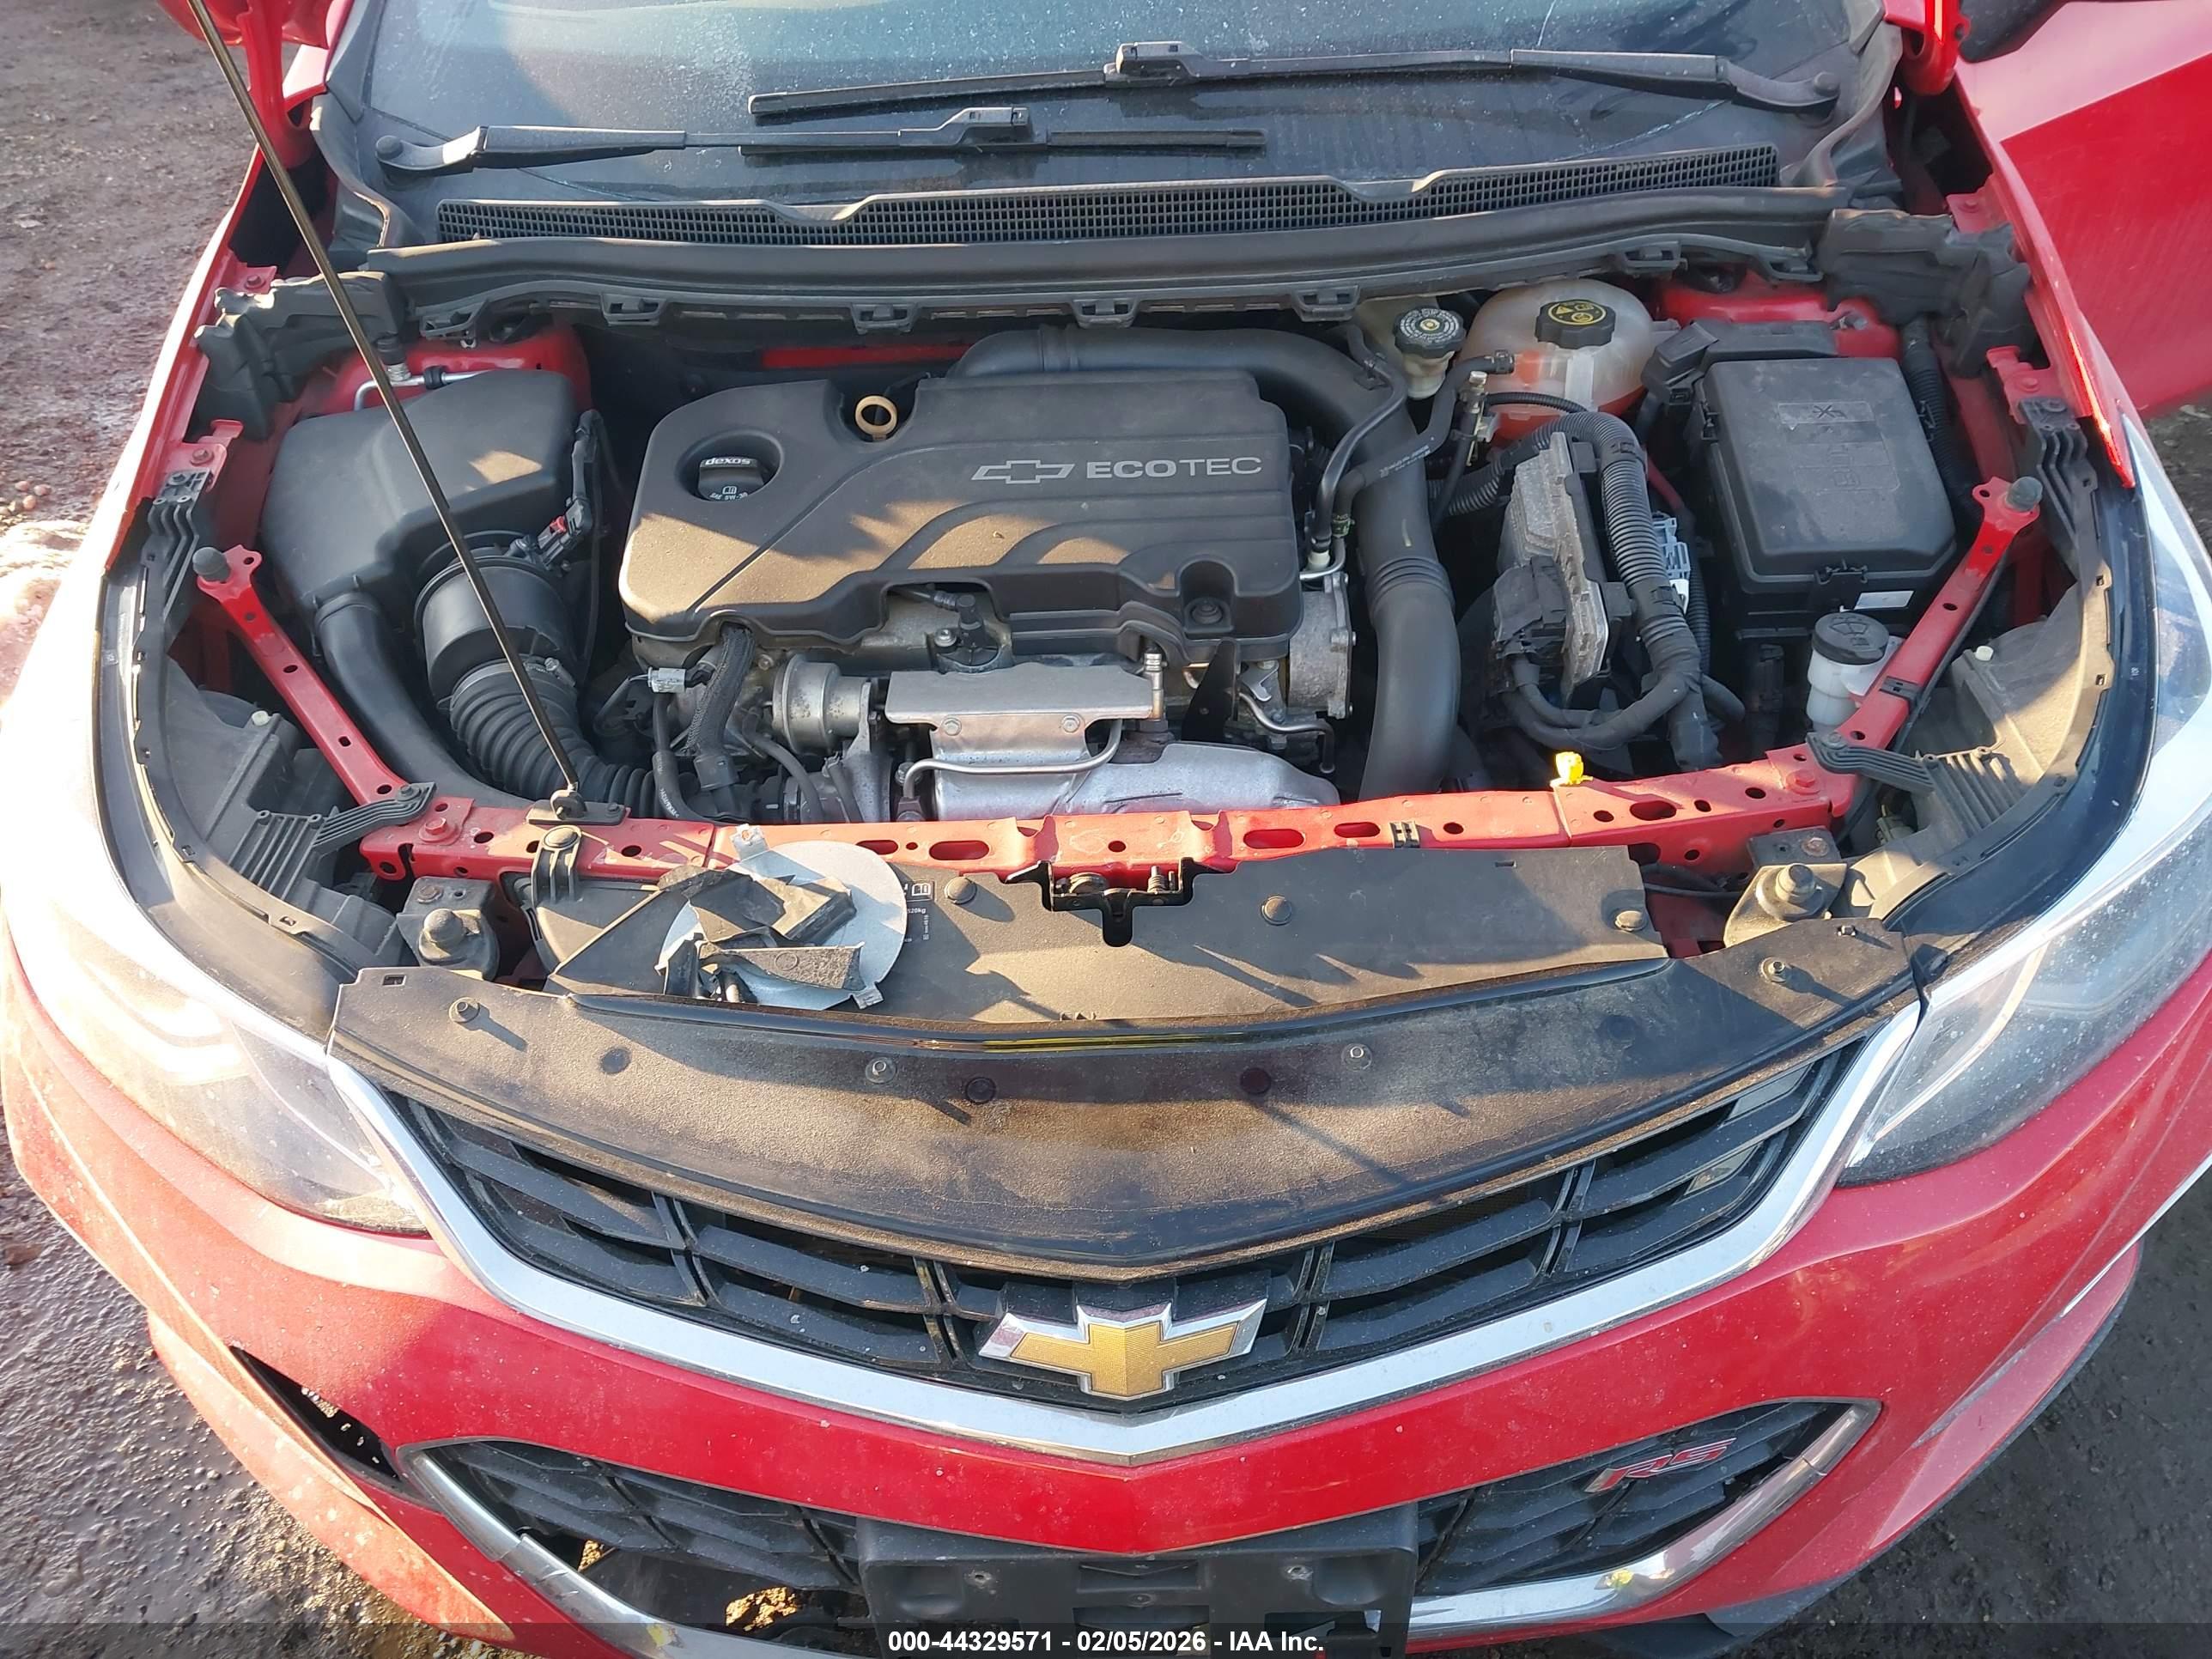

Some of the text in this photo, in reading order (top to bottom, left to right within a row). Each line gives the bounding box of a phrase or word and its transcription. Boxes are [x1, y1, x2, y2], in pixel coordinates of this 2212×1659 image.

[705, 457, 750, 465] dexos
[1086, 457, 1261, 478] ECOTEC
[1583, 1437, 1737, 1493] RS
